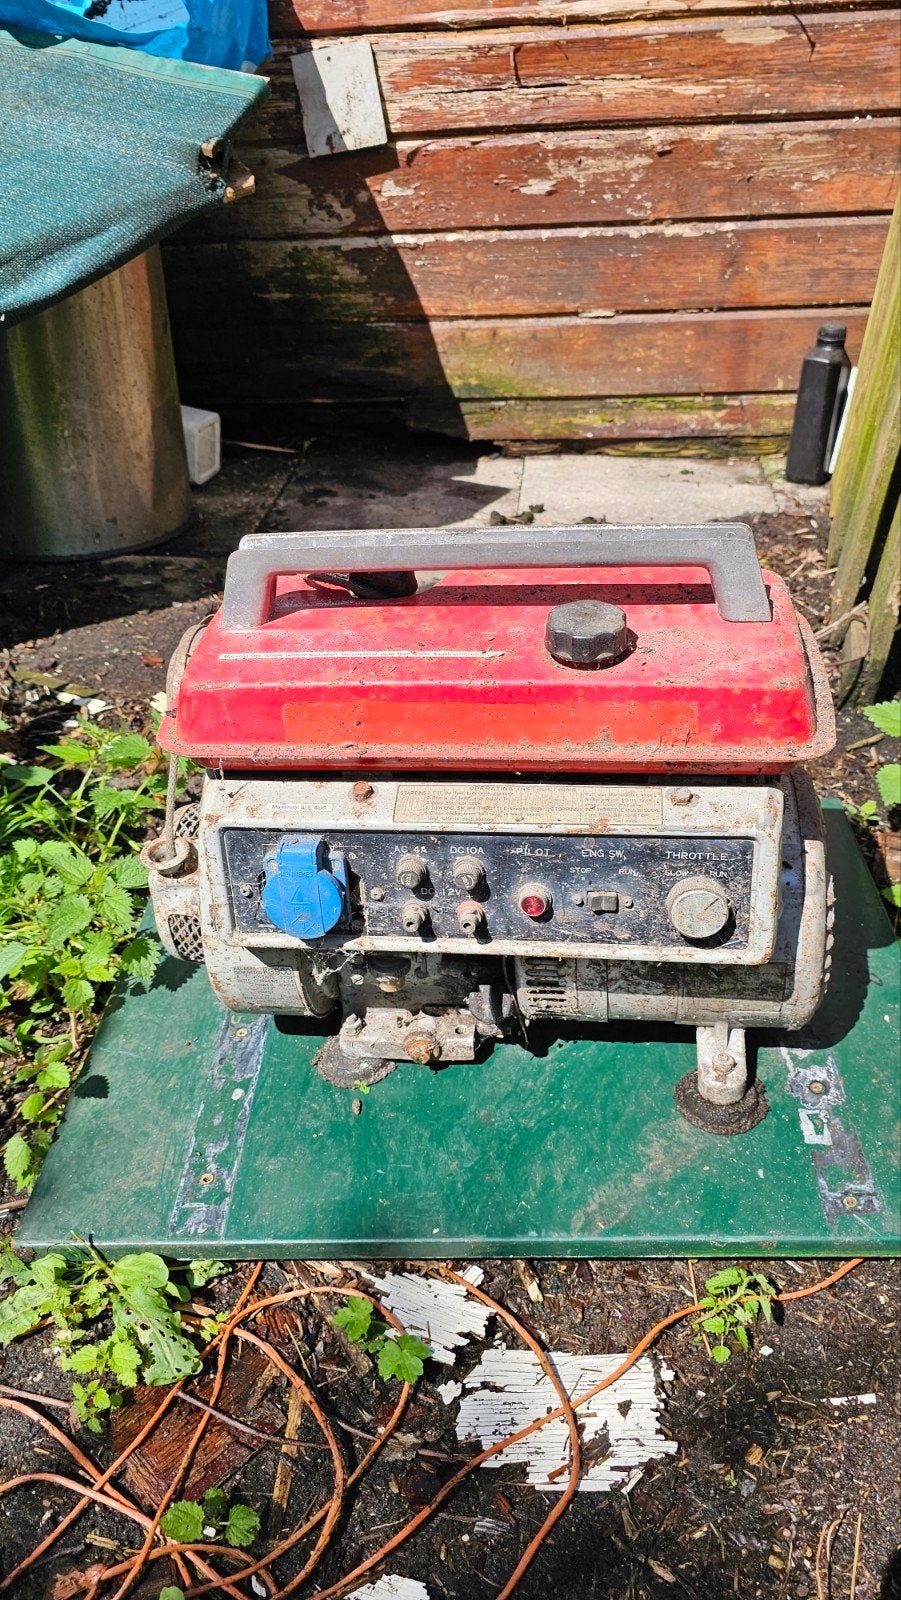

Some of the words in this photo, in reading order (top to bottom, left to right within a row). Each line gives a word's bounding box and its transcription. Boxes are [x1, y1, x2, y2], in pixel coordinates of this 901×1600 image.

[394, 846, 411, 854] AC
[413, 846, 428, 854] 4A
[516, 847, 551, 856] PILOT
[581, 850, 604, 858] ENG
[665, 851, 728, 861] THROTTLE
[618, 868, 637, 876] RUN
[709, 870, 728, 878] RUN
[421, 887, 435, 896] DC
